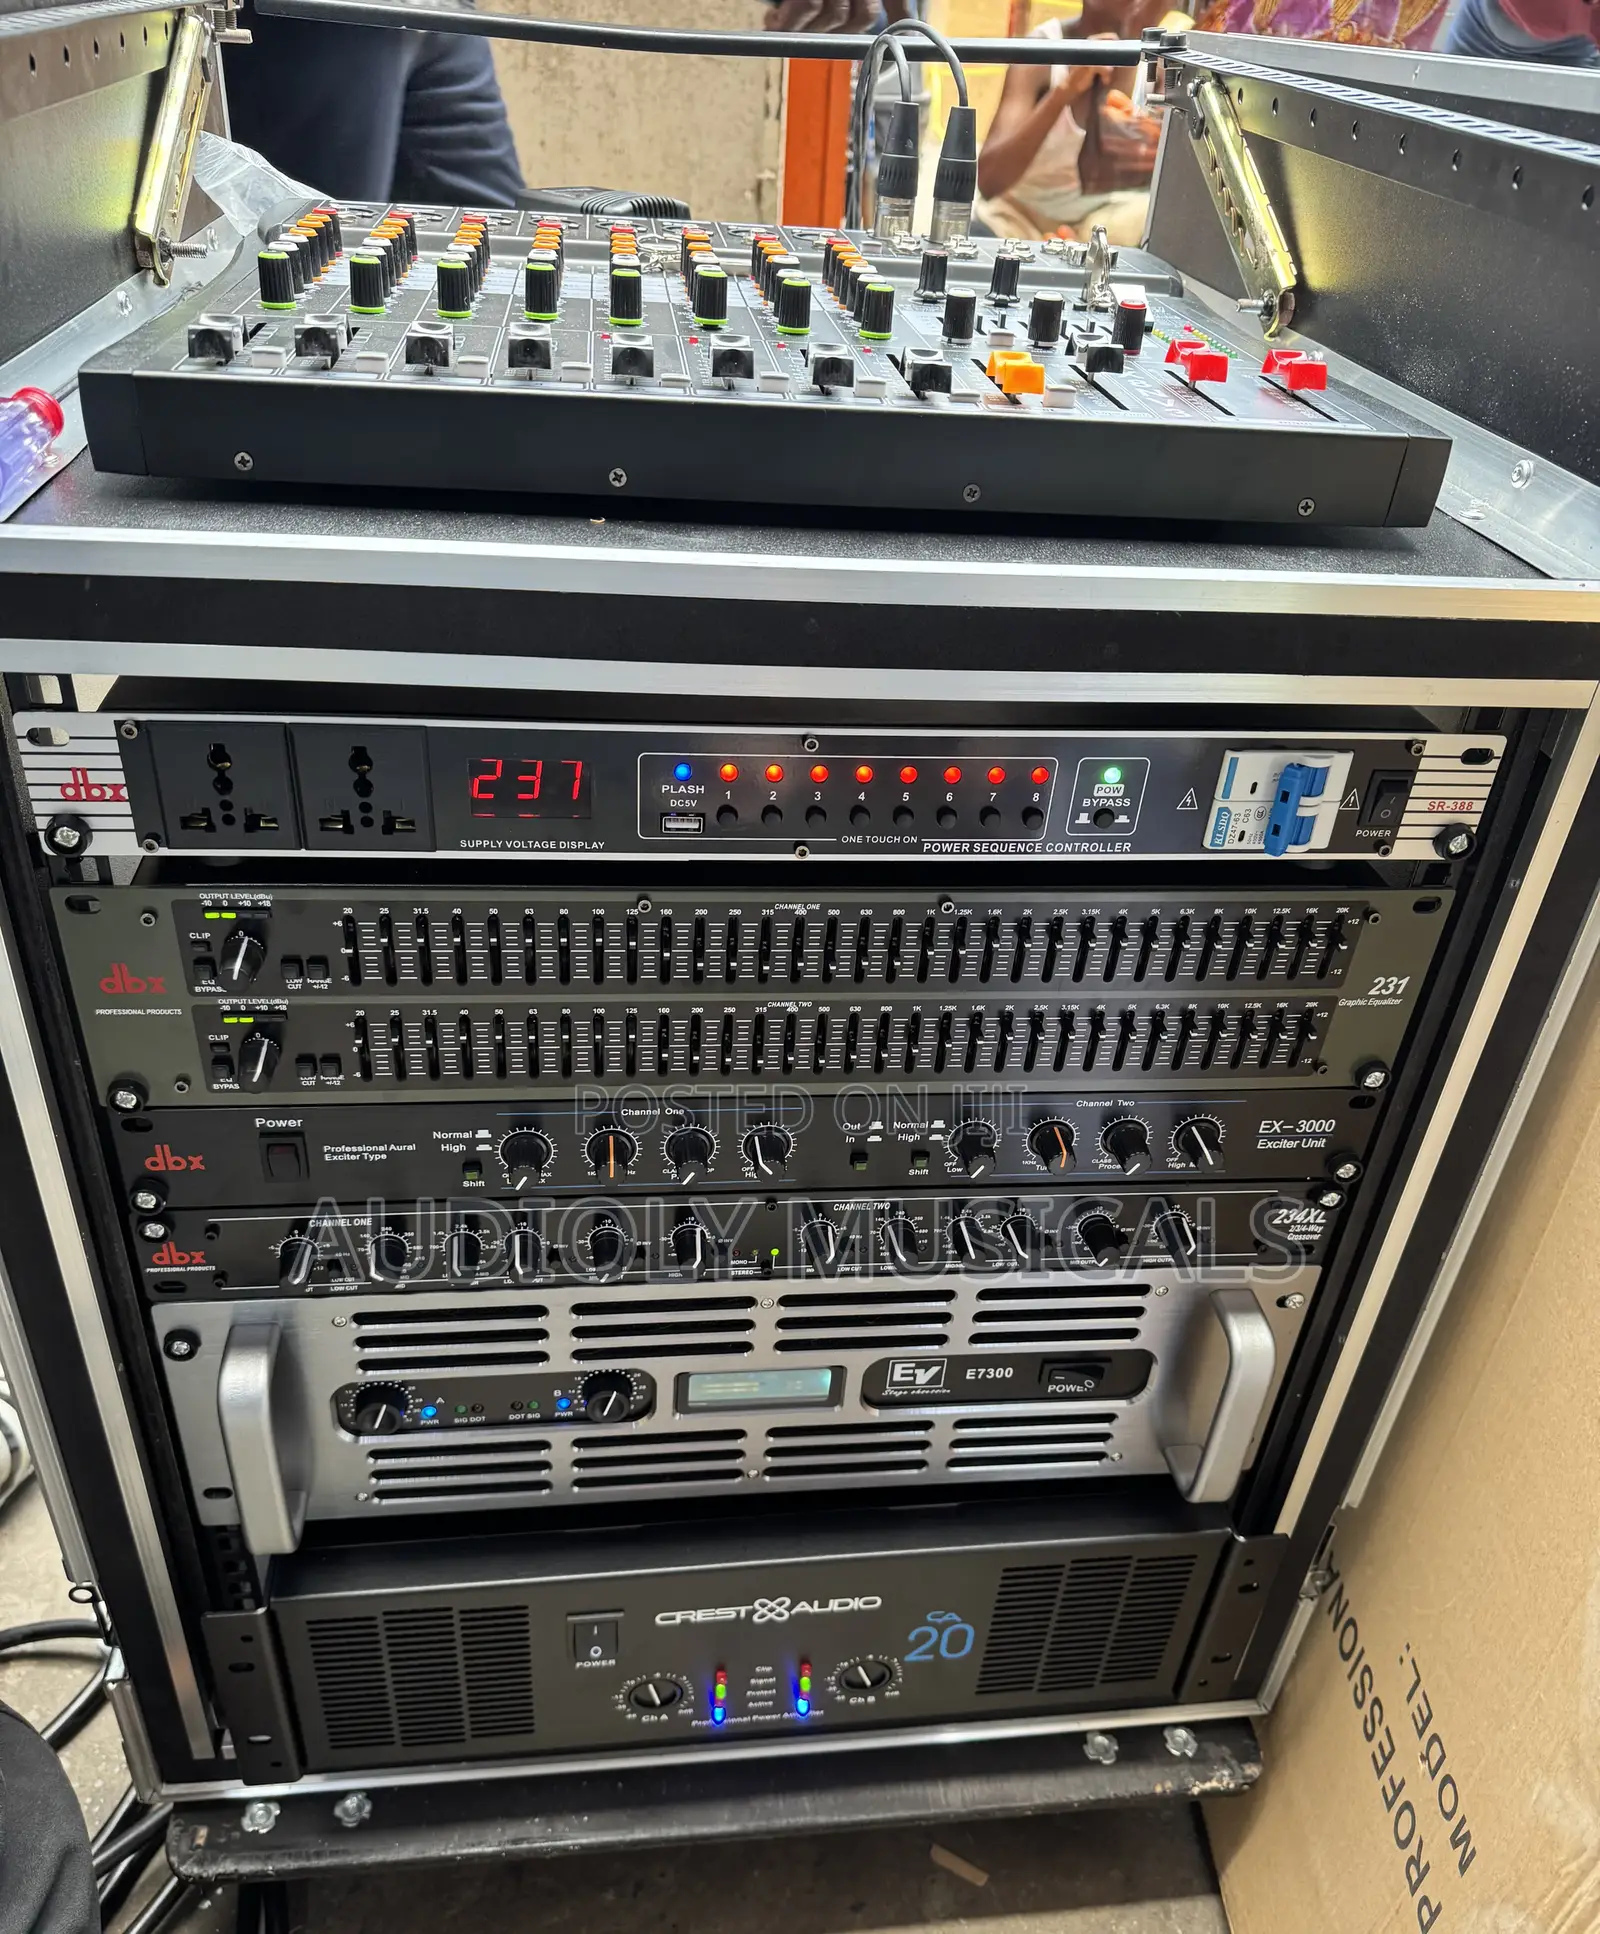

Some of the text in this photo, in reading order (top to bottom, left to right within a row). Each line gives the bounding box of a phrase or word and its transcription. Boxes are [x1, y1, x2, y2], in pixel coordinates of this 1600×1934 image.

[60, 767, 129, 801] dbx
[471, 759, 584, 799] 237
[661, 784, 705, 794] PLASH
[1097, 785, 1122, 795] POW
[726, 791, 1039, 801] 1 2 3 4 5 6 7 8
[670, 798, 698, 808] DC5V
[1083, 797, 1131, 808] BYPASS
[1427, 801, 1474, 812] SR-388
[1355, 829, 1392, 838] POWER
[841, 835, 918, 844] ONE TOUCH ON
[460, 839, 606, 851] SUPPLY VOLTAGE DISPLAY
[923, 842, 1132, 854] POWER SEQUENCE CONTROLLER
[99, 962, 168, 994] dbx
[1368, 976, 1410, 995] 231
[1338, 998, 1403, 1007] Graphic Equalizer
[95, 1008, 182, 1016] PROFESSIONAL PRODUCTS
[1076, 1100, 1113, 1108] Channel
[621, 1107, 685, 1116] Channel One
[255, 1117, 303, 1129] Power
[893, 1121, 929, 1129] Normal
[433, 1130, 473, 1139] Normal
[898, 1133, 921, 1142] High
[323, 1143, 416, 1153] Professional Aural
[441, 1143, 466, 1153] High
[1257, 1138, 1327, 1149] Exciter Unit
[144, 1144, 205, 1171] dbx
[324, 1152, 387, 1161] Exciter Type
[908, 1168, 929, 1176] Shift
[463, 1179, 485, 1188] Shift
[833, 1202, 891, 1211] CHANNEL TWO
[1271, 1209, 1327, 1224] 234XL
[309, 1217, 373, 1227] CHANNEL ONE
[152, 1241, 206, 1265] dbx
[146, 1265, 184, 1273] PROFESSIONAL
[966, 1367, 1014, 1379] E7300
[655, 1595, 882, 1626] CREST AUDIO
[904, 1623, 976, 1663] 20
[575, 1658, 617, 1669] POWER
